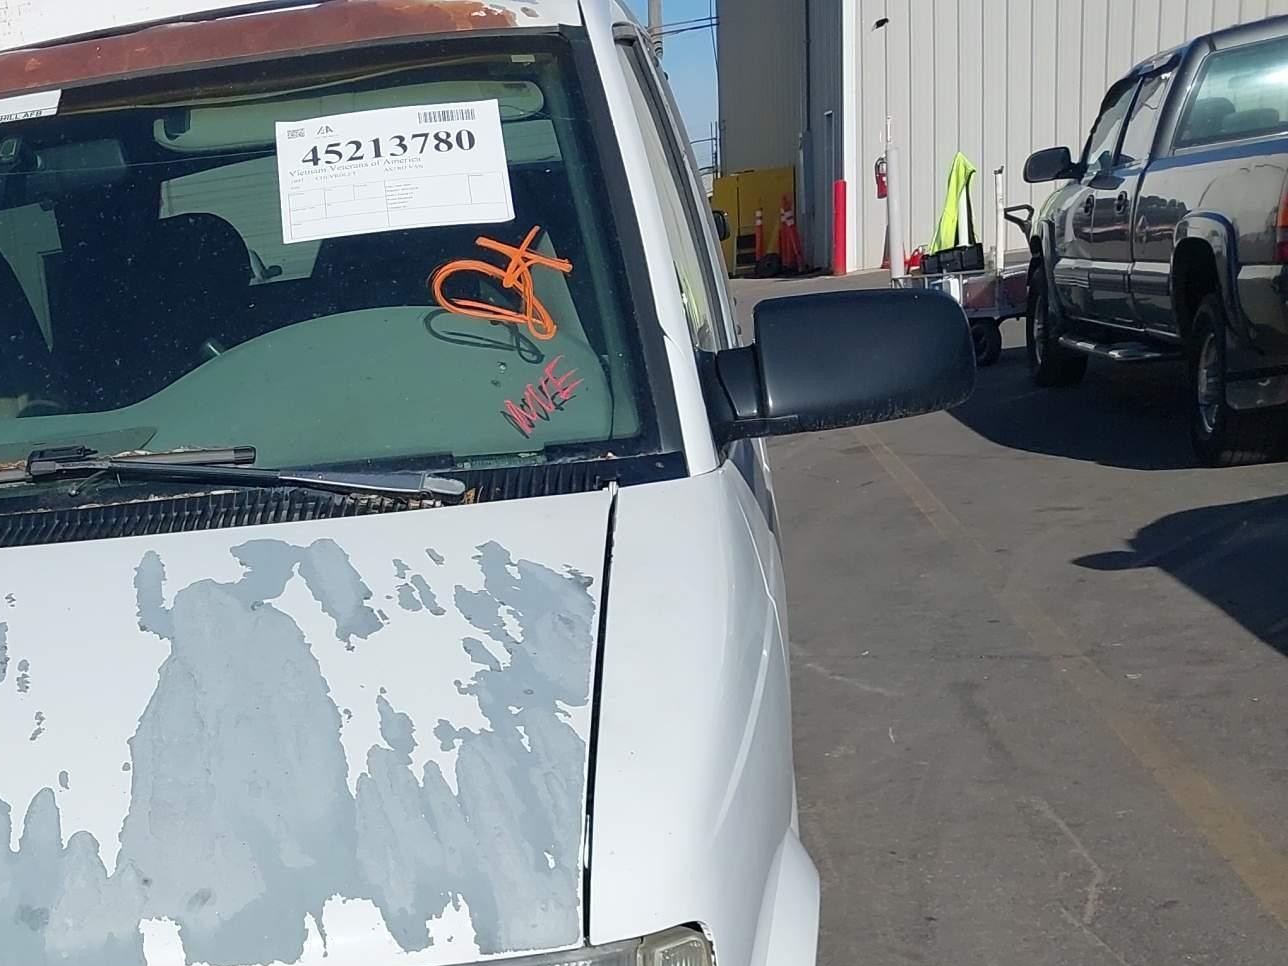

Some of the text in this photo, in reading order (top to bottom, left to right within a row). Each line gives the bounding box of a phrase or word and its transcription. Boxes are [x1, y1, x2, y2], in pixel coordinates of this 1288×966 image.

[0, 110, 42, 122] HILL AFB
[302, 128, 475, 166] 45213780
[289, 157, 421, 177] Vietnam Veterans of America
